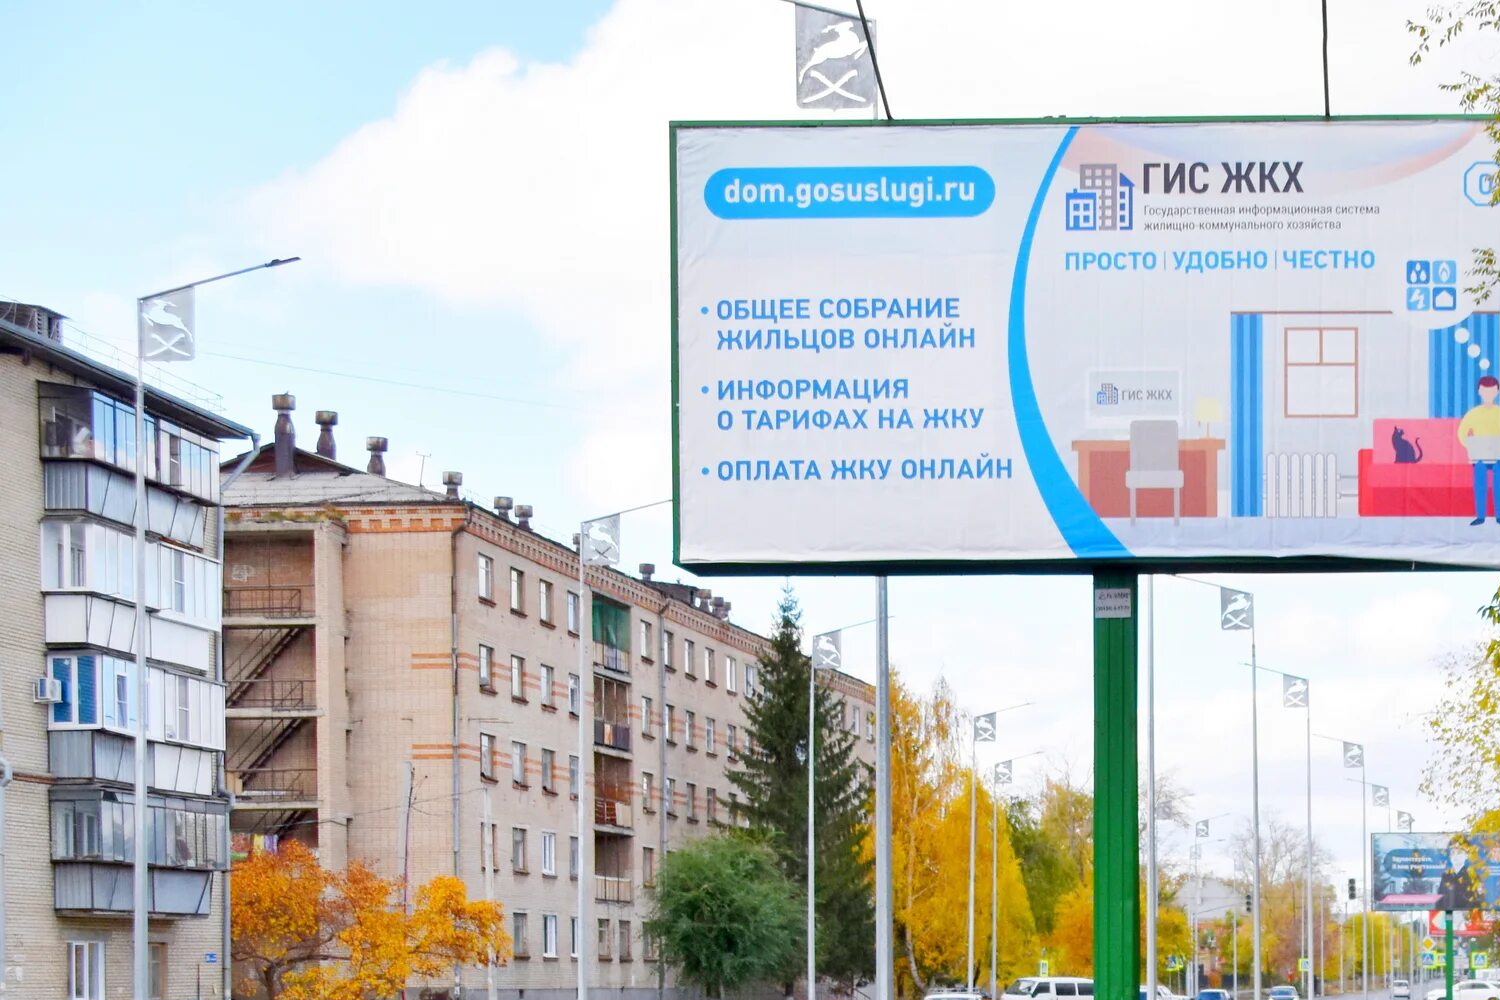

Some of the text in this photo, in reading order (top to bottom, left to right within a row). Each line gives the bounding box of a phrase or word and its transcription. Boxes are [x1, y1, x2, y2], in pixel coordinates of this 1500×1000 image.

[1144, 162, 1303, 194] ГИС ЖКХ
[725, 177, 974, 208] dom.gosuslugi.ru
[1144, 204, 1380, 217] Государственная информационная система
[1287, 218, 1342, 230] хозяйства
[1066, 250, 1375, 273] ПРОСТО УДОБНО ЧЕСТНО
[717, 298, 959, 323] ОБЩЕЕ СОБРАНИЕ
[718, 322, 975, 353] ЖИЛЬЦОВ ОНЛАЙН
[718, 379, 908, 403] ИНФОРМАЦИЯ
[1121, 389, 1172, 400] ГИС ЖКХ
[718, 408, 984, 430] О ТАРИФАХ НА ЖКУ
[718, 452, 1011, 481] ОПЛАТА ЖКУ ОНЛАЙН
